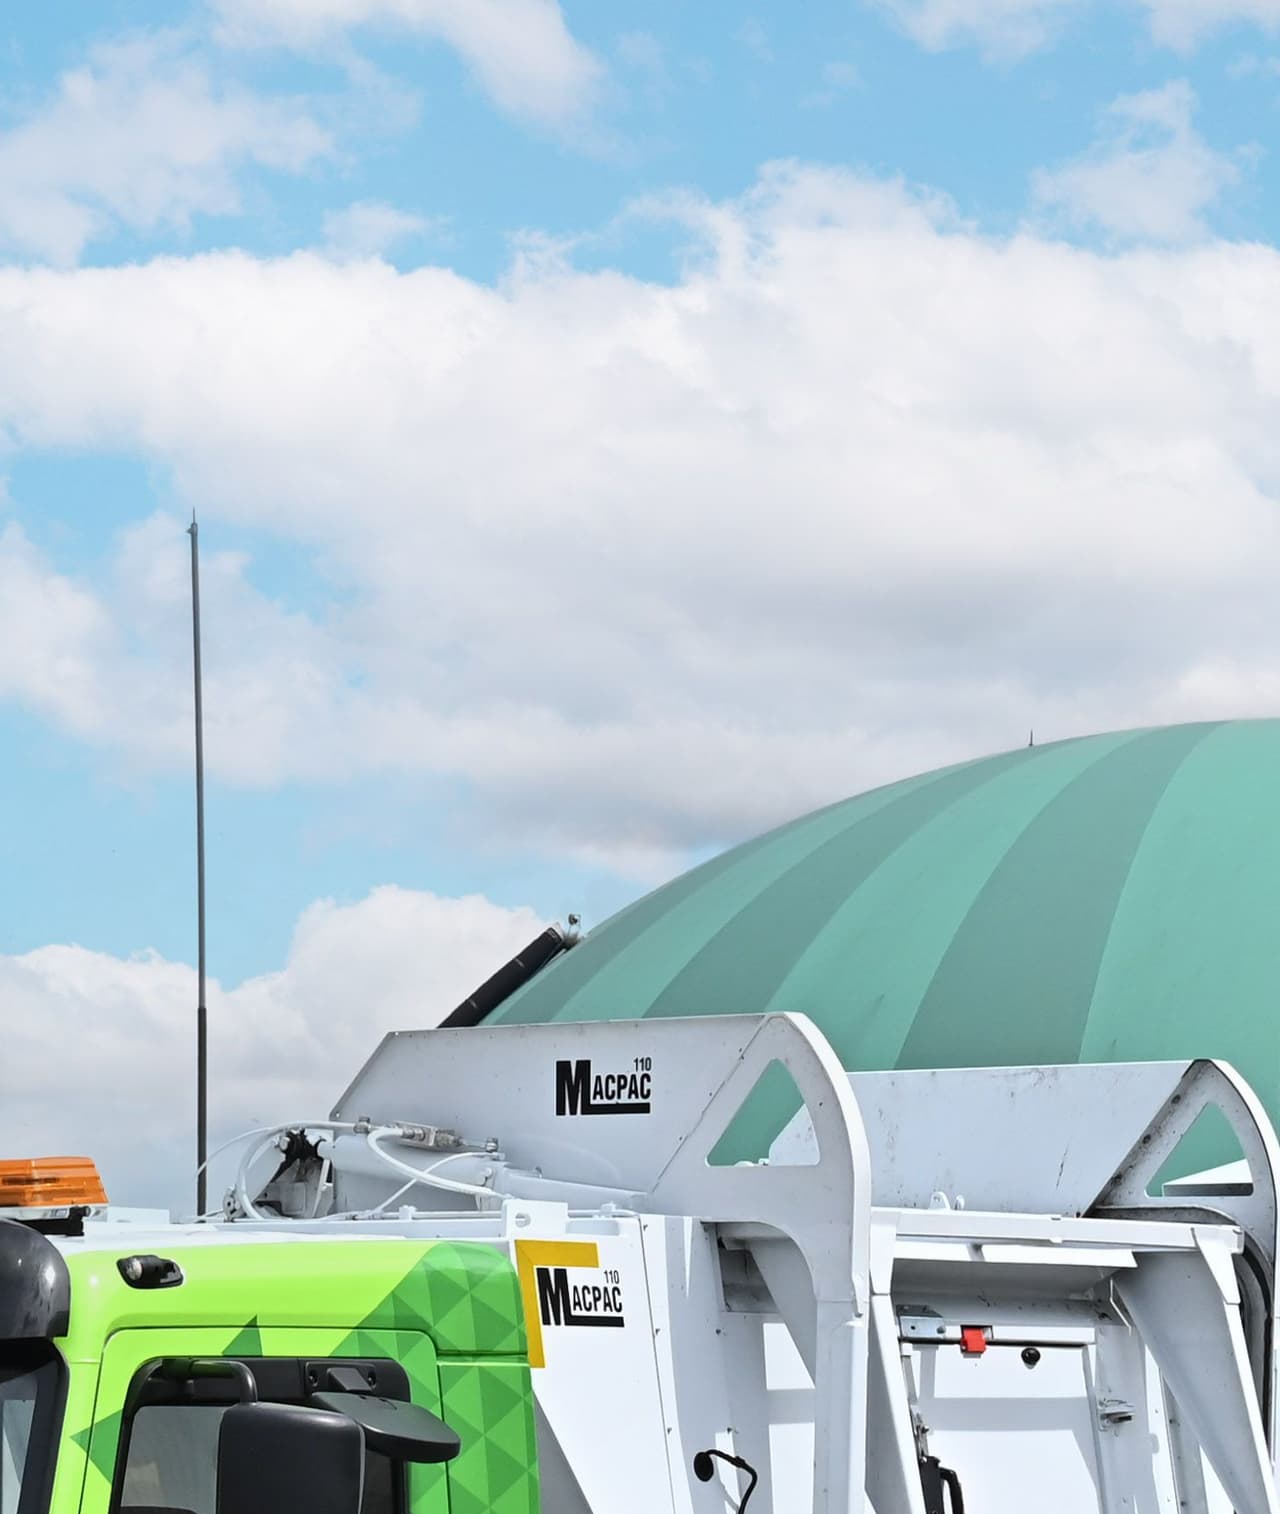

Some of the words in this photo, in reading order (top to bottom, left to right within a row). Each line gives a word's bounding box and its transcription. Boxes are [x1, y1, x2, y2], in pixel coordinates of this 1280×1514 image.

[634, 1057, 652, 1072] 110
[555, 1059, 651, 1116] MACPAC
[604, 1270, 620, 1284] 110
[536, 1267, 625, 1327] MACPAC
